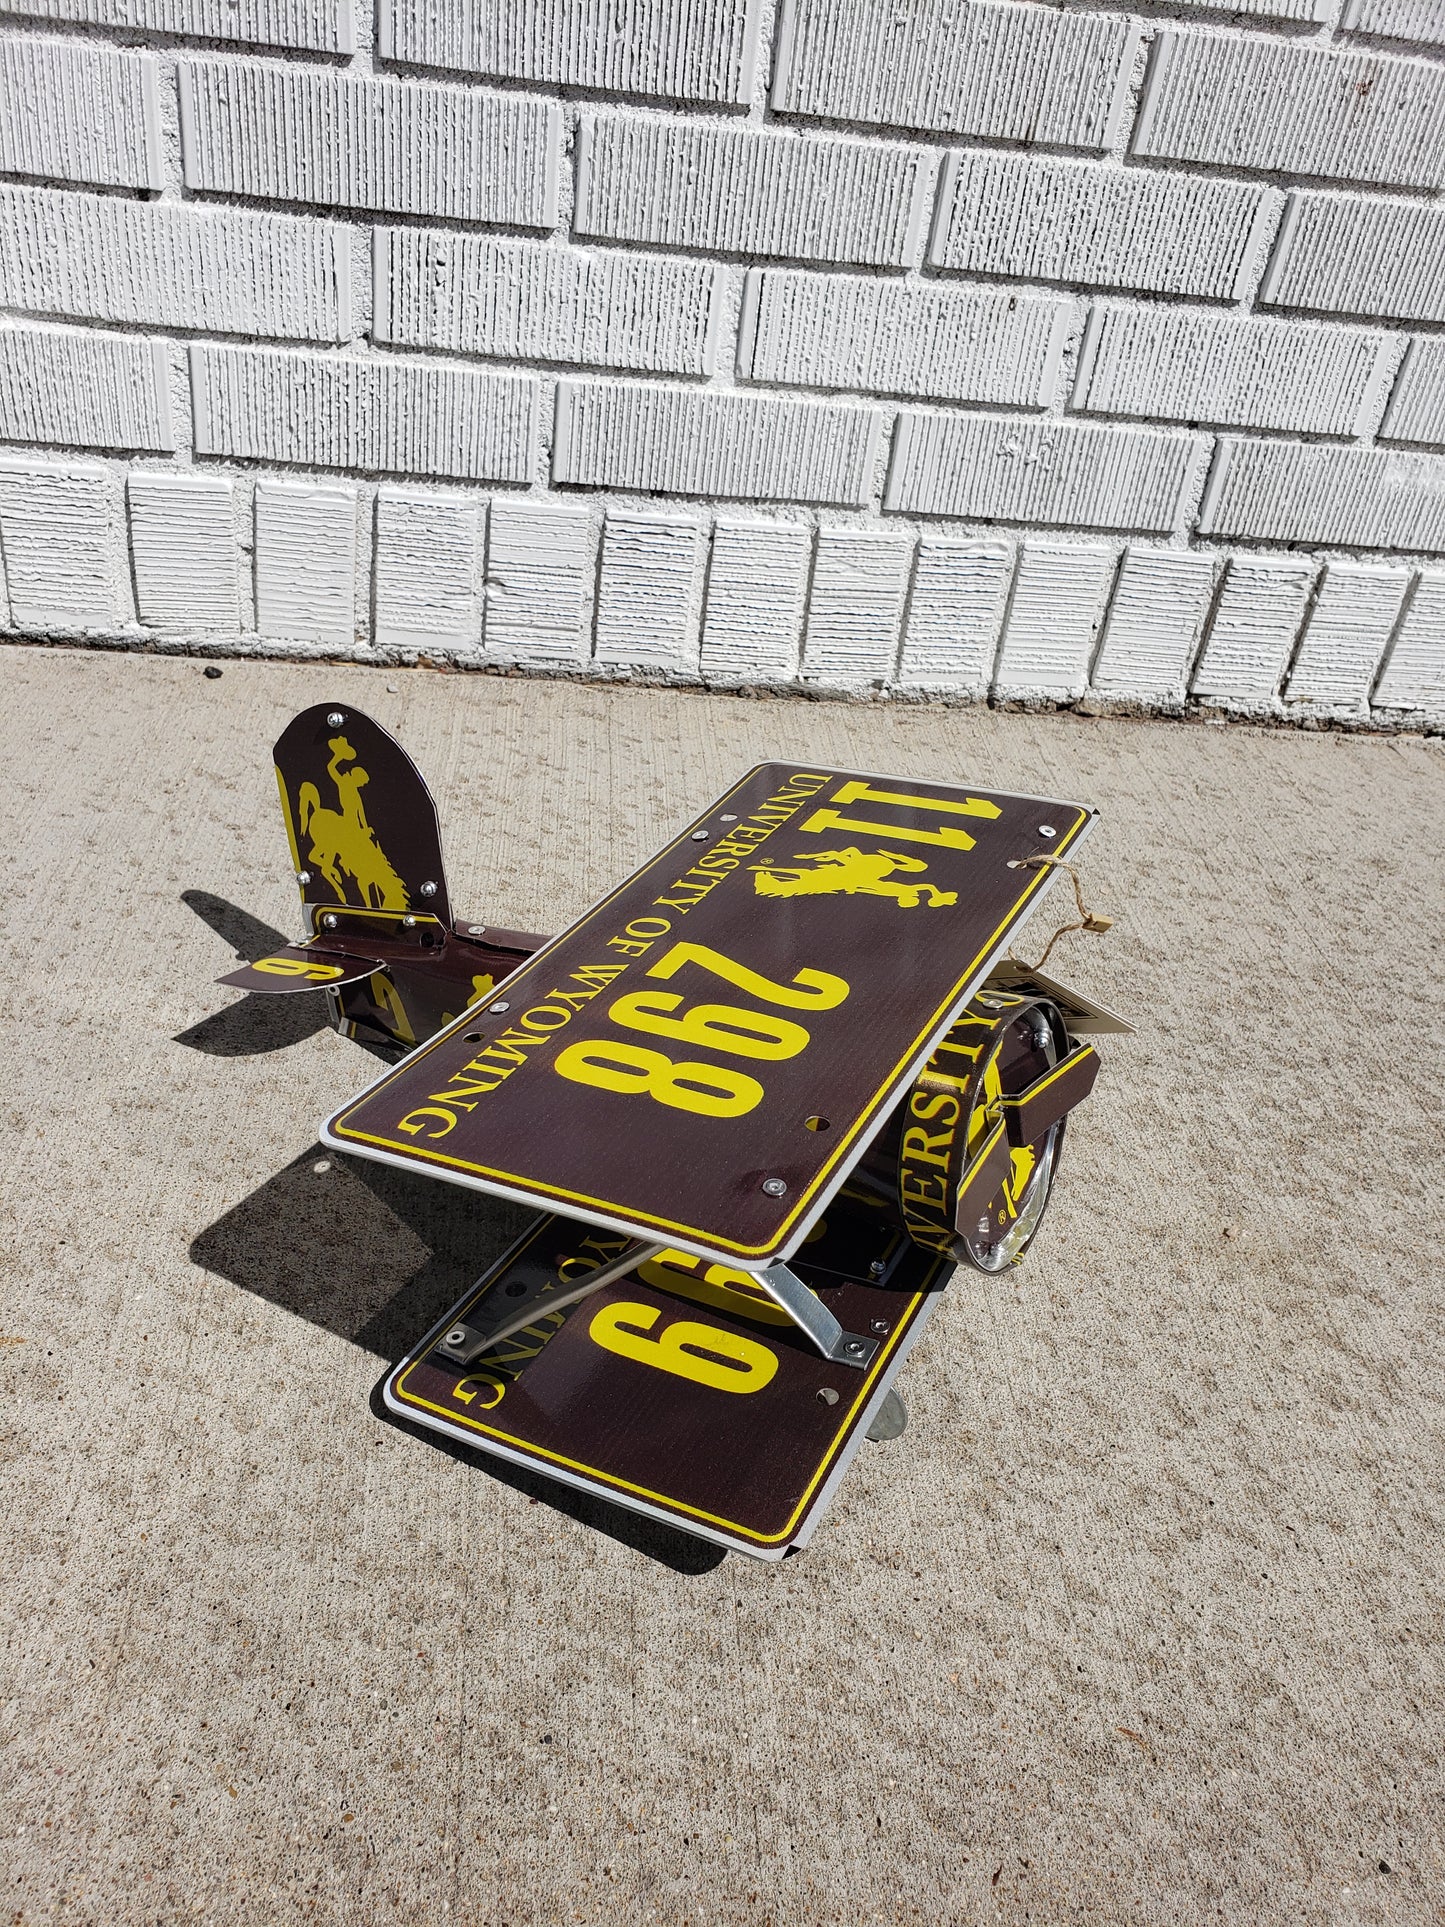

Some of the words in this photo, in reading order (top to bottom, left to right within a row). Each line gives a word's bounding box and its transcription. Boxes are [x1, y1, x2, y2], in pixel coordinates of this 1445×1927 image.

[652, 773, 833, 915] UNIVERSITY
[798, 780, 1003, 852] 11
[606, 916, 673, 958] OF
[397, 963, 630, 1139] WYOMING
[553, 940, 850, 1119] 298
